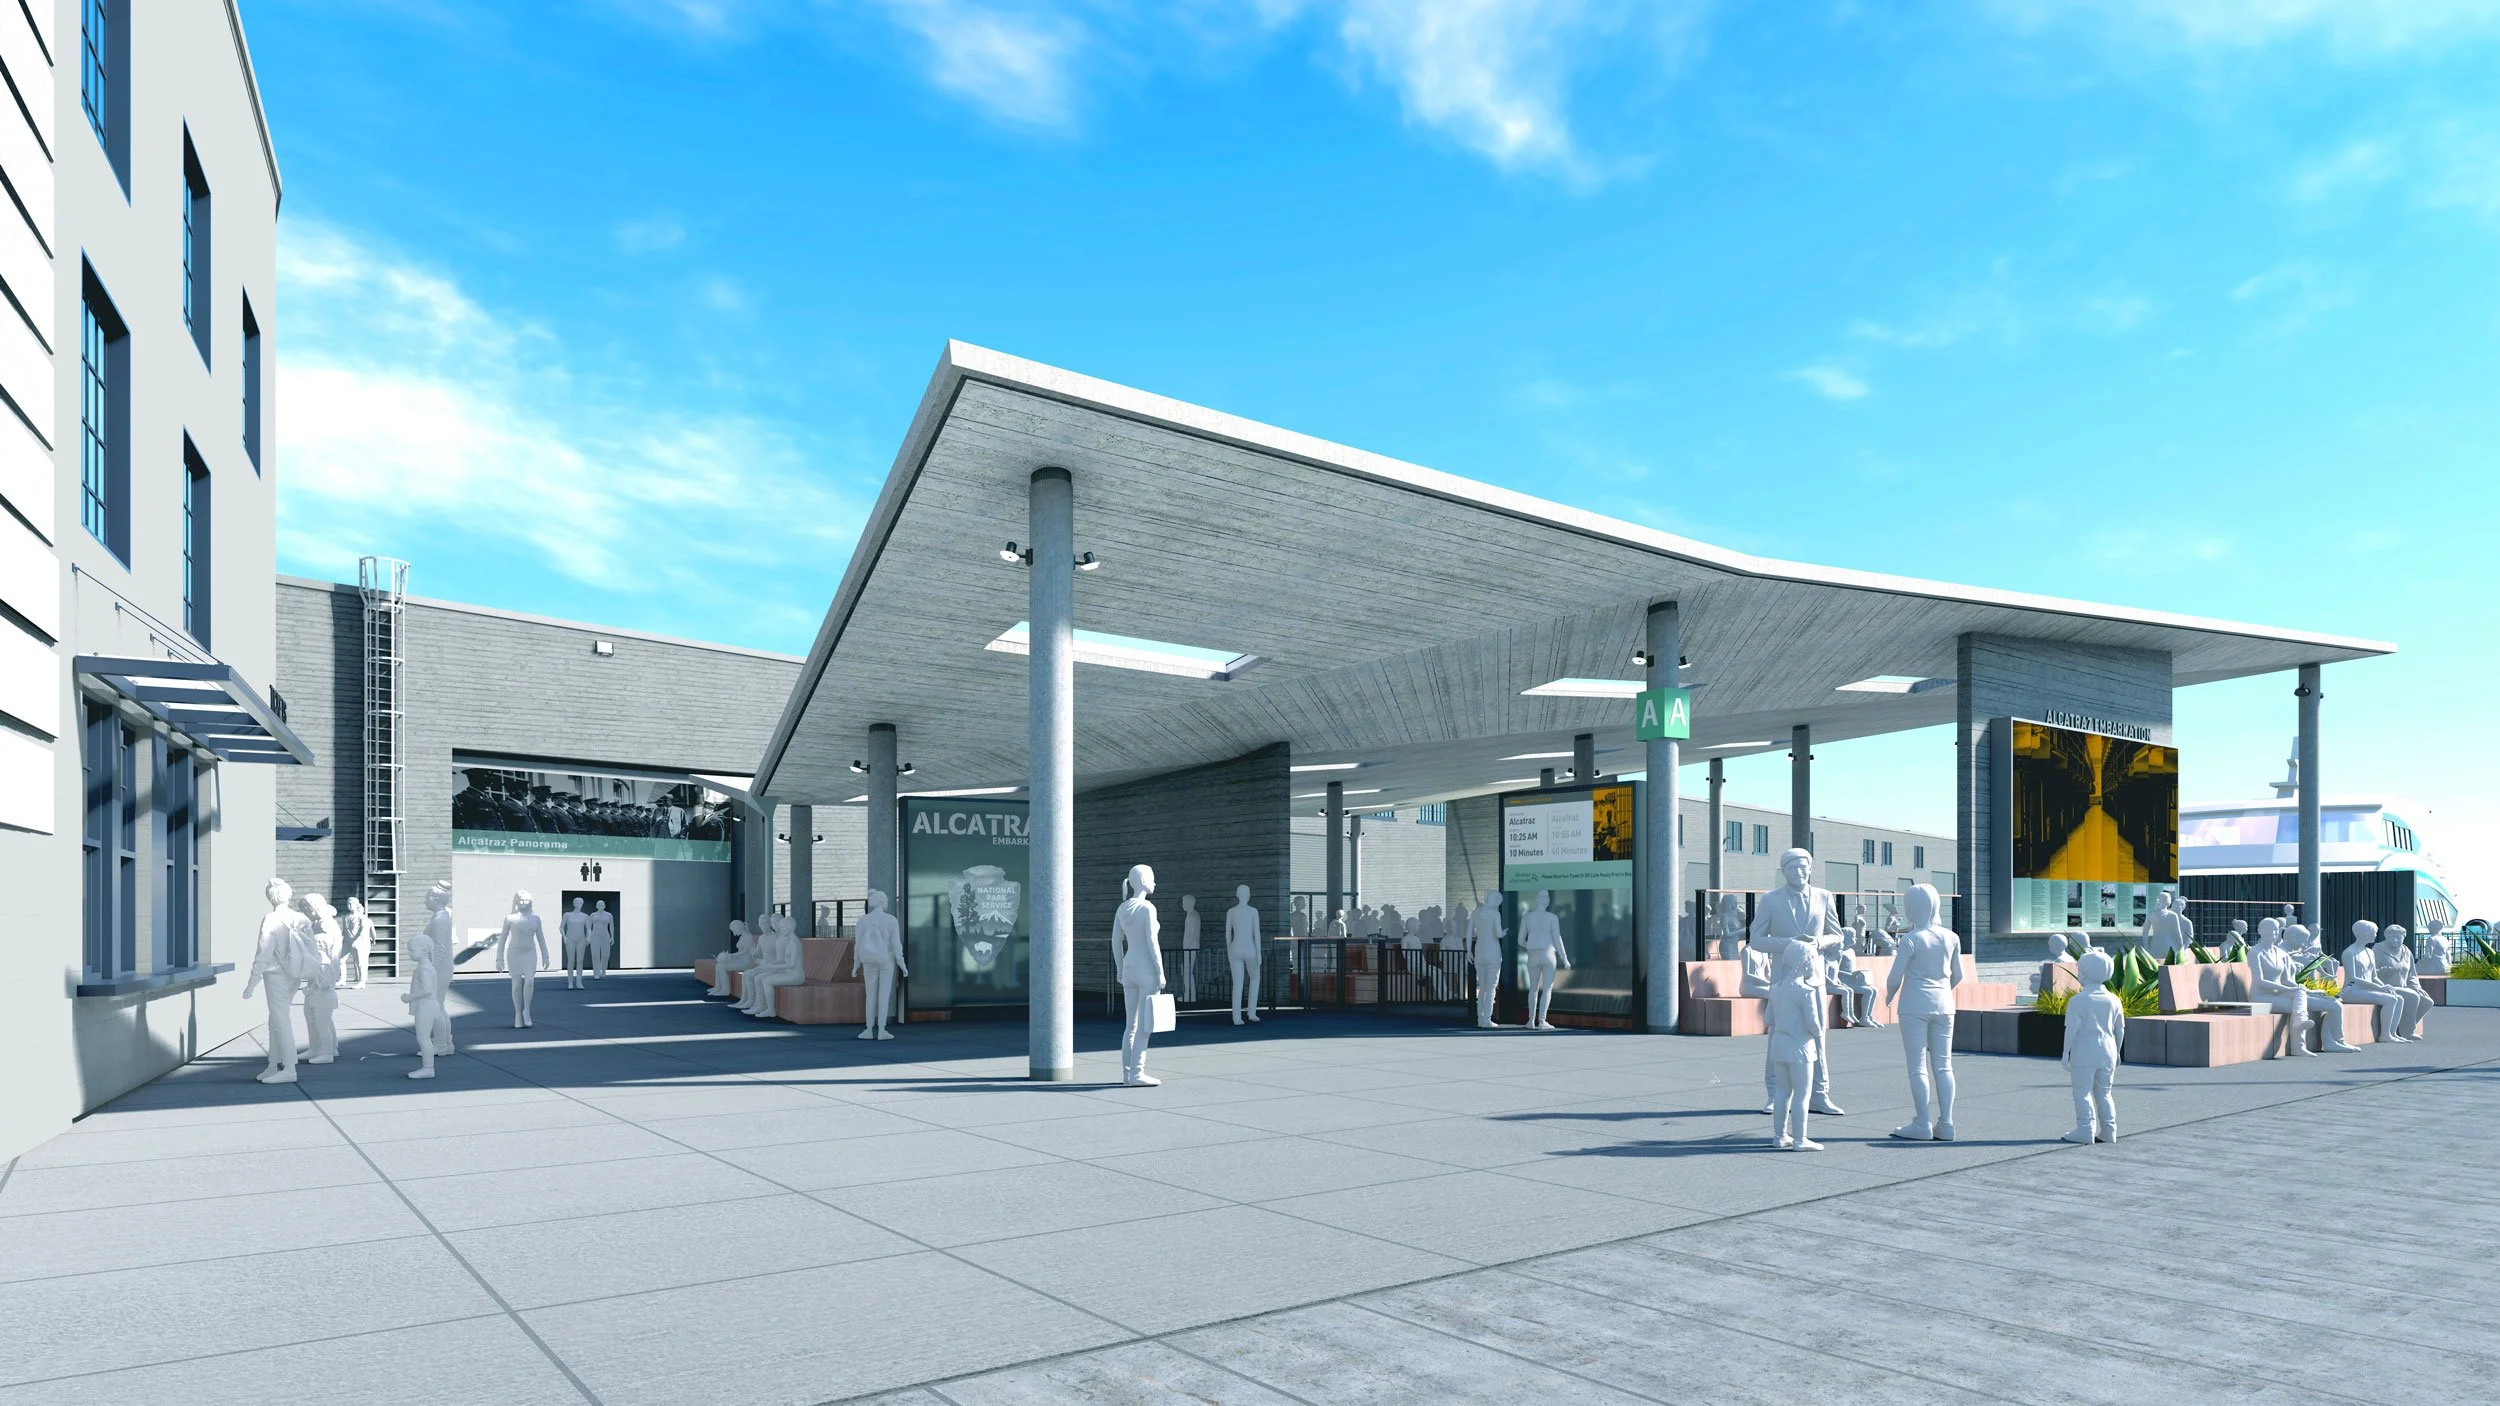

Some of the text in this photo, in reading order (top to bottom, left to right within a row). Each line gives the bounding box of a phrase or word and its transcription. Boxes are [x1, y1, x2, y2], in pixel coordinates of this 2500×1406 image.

[1641, 699, 1659, 728] A
[1669, 697, 1687, 727] A
[2045, 709, 2151, 741] ALCATRAZ EMBARKATION
[1509, 817, 1536, 826] Alcatraz
[1551, 814, 1579, 823] Alcatraz
[1509, 832, 1538, 841] 10:25 AM
[458, 836, 568, 849] Alcatraz Panorama
[1509, 848, 1544, 858] 10 Minutes
[981, 901, 1012, 909] SERVICE
